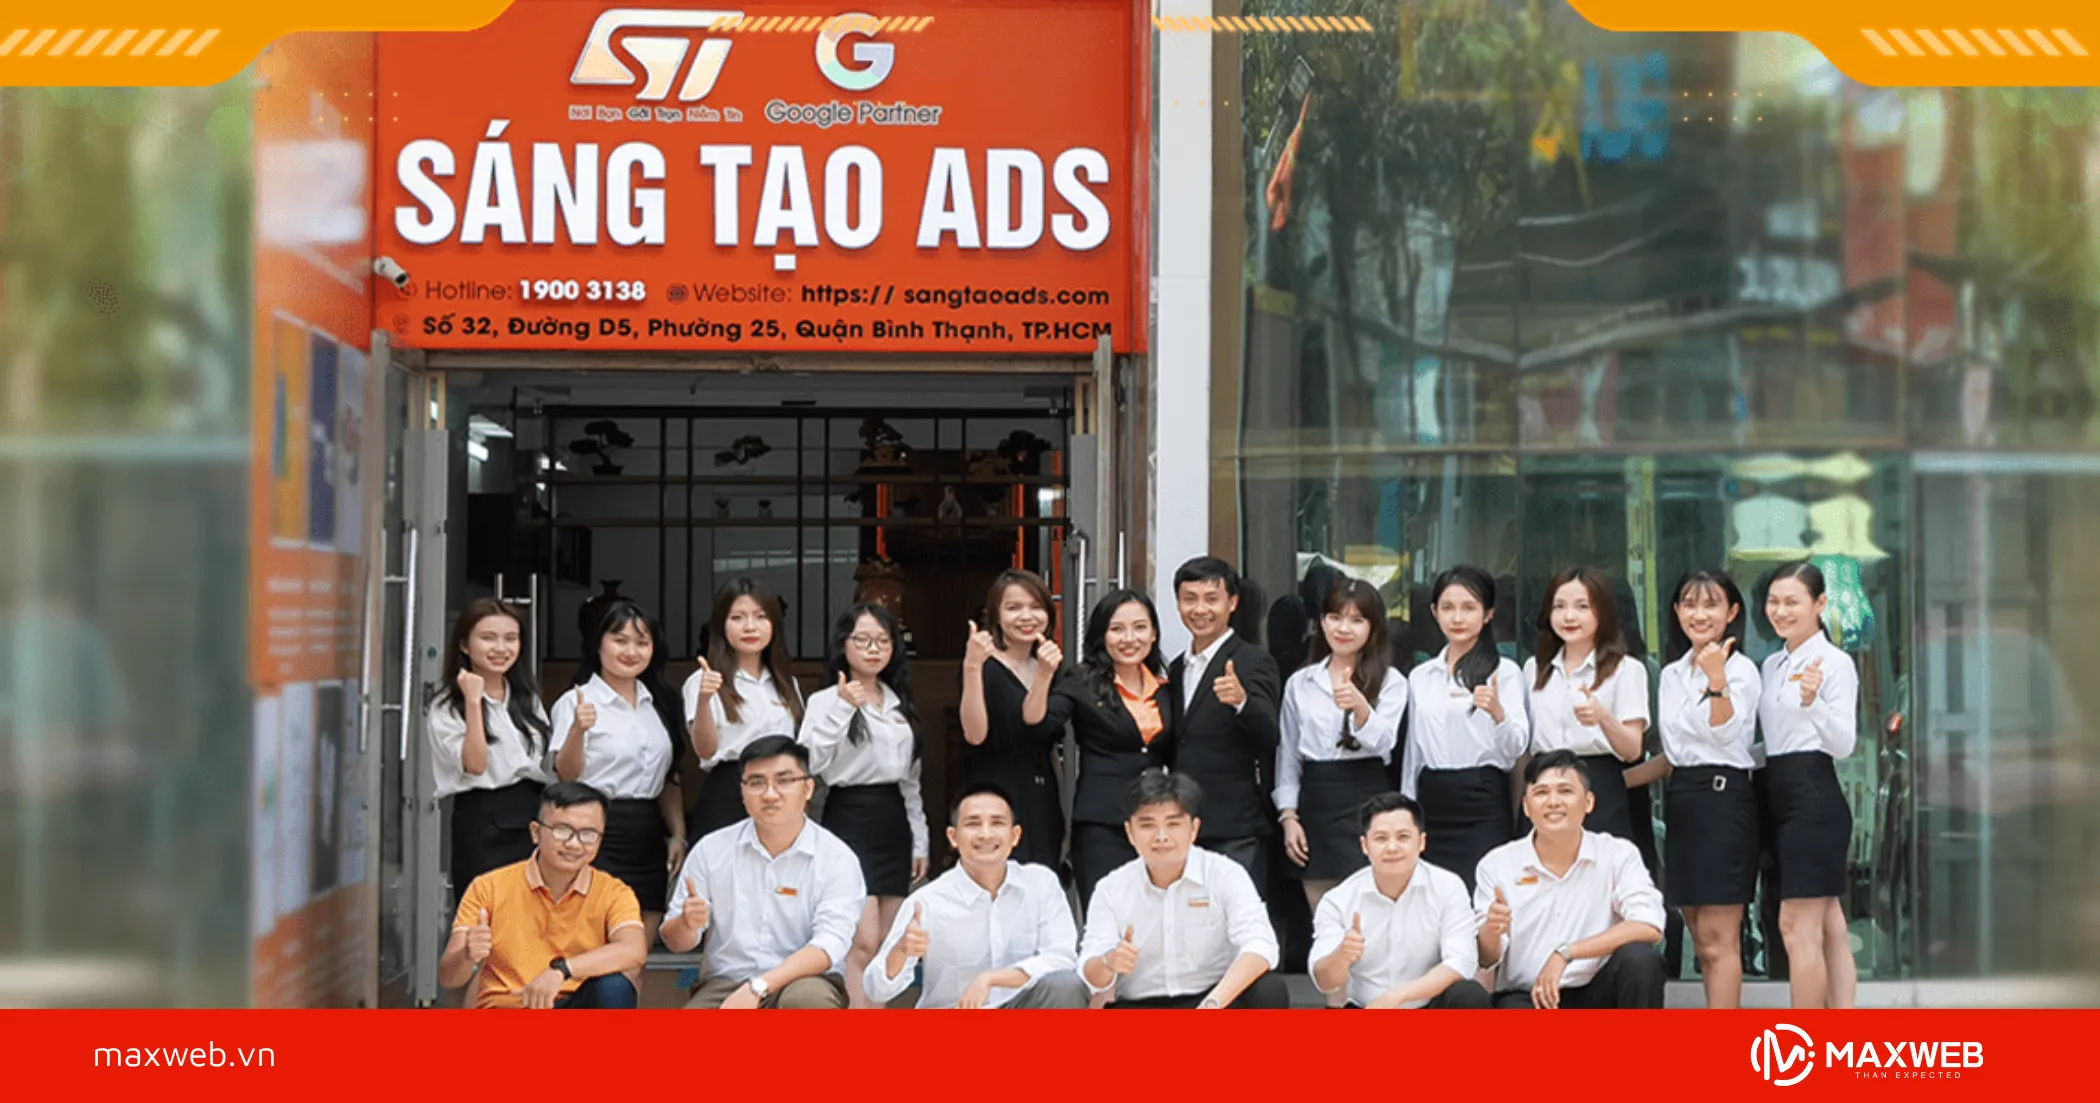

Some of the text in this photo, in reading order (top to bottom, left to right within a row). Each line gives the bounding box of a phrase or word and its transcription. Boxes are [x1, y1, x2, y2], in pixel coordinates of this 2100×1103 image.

[765, 100, 942, 128] Google Partner
[394, 119, 1111, 271] SÁNG TẠO ADS
[425, 279, 646, 301] Hotline: 1900 3138
[693, 283, 792, 305] Website:
[904, 287, 1110, 308] sangtaoads.com
[423, 313, 1112, 343] Số 32, Đường D5, Phường 25, Quận Bình Thạnh, TP.HCM
